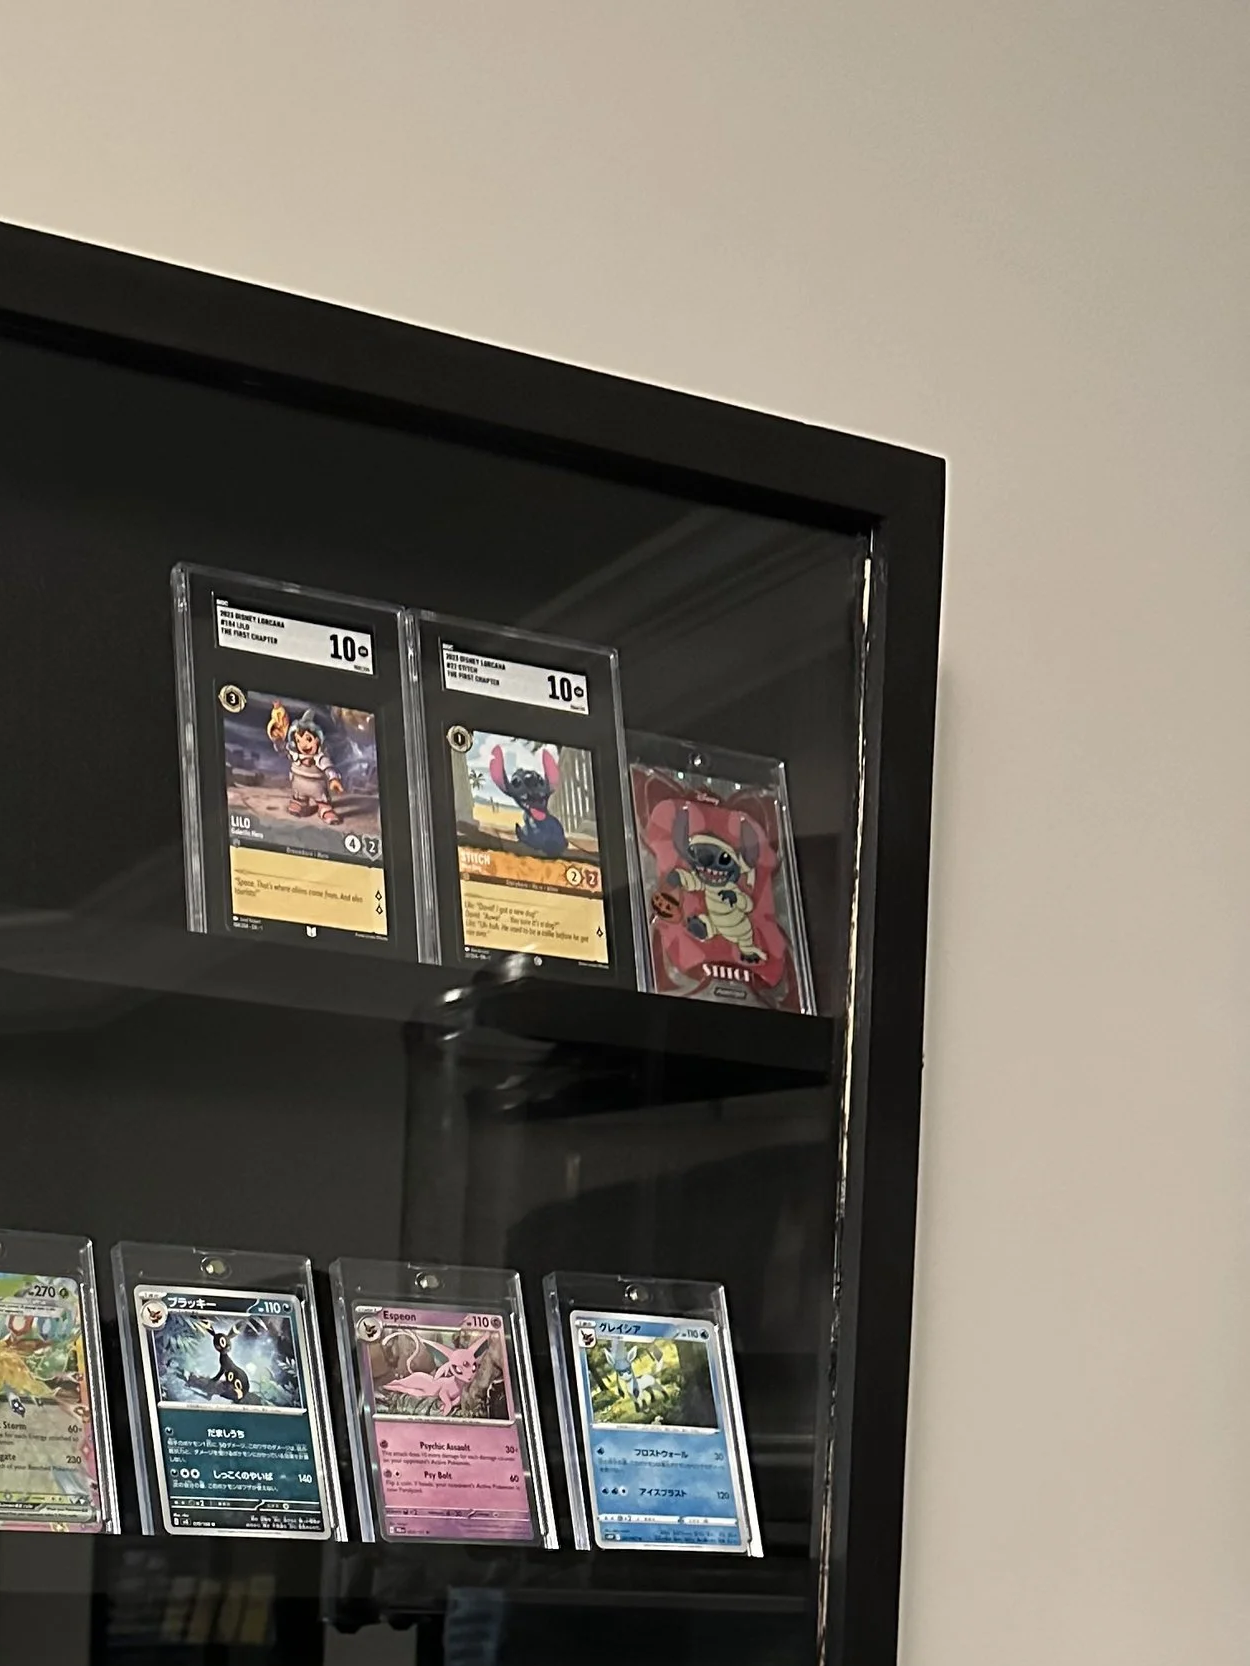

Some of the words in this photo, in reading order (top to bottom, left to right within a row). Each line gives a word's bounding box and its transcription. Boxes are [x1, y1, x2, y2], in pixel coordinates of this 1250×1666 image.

[221, 628, 232, 637] THE
[233, 630, 250, 640] FIRST
[251, 633, 277, 644] CHAPTER
[330, 634, 356, 662] 10
[548, 675, 572, 701] 10
[230, 695, 236, 704] 3
[231, 815, 250, 828] LILO
[349, 838, 355, 849] 4
[369, 841, 375, 851] 2
[461, 852, 491, 865] STITCH
[571, 873, 577, 884] 2
[589, 874, 595, 884] 2
[167, 1297, 216, 1308] ブラッキー
[383, 1311, 416, 1322] Espeon
[599, 1323, 640, 1335] グレイシア
[3, 1421, 26, 1430] Storm
[717, 1491, 729, 1500] 120
